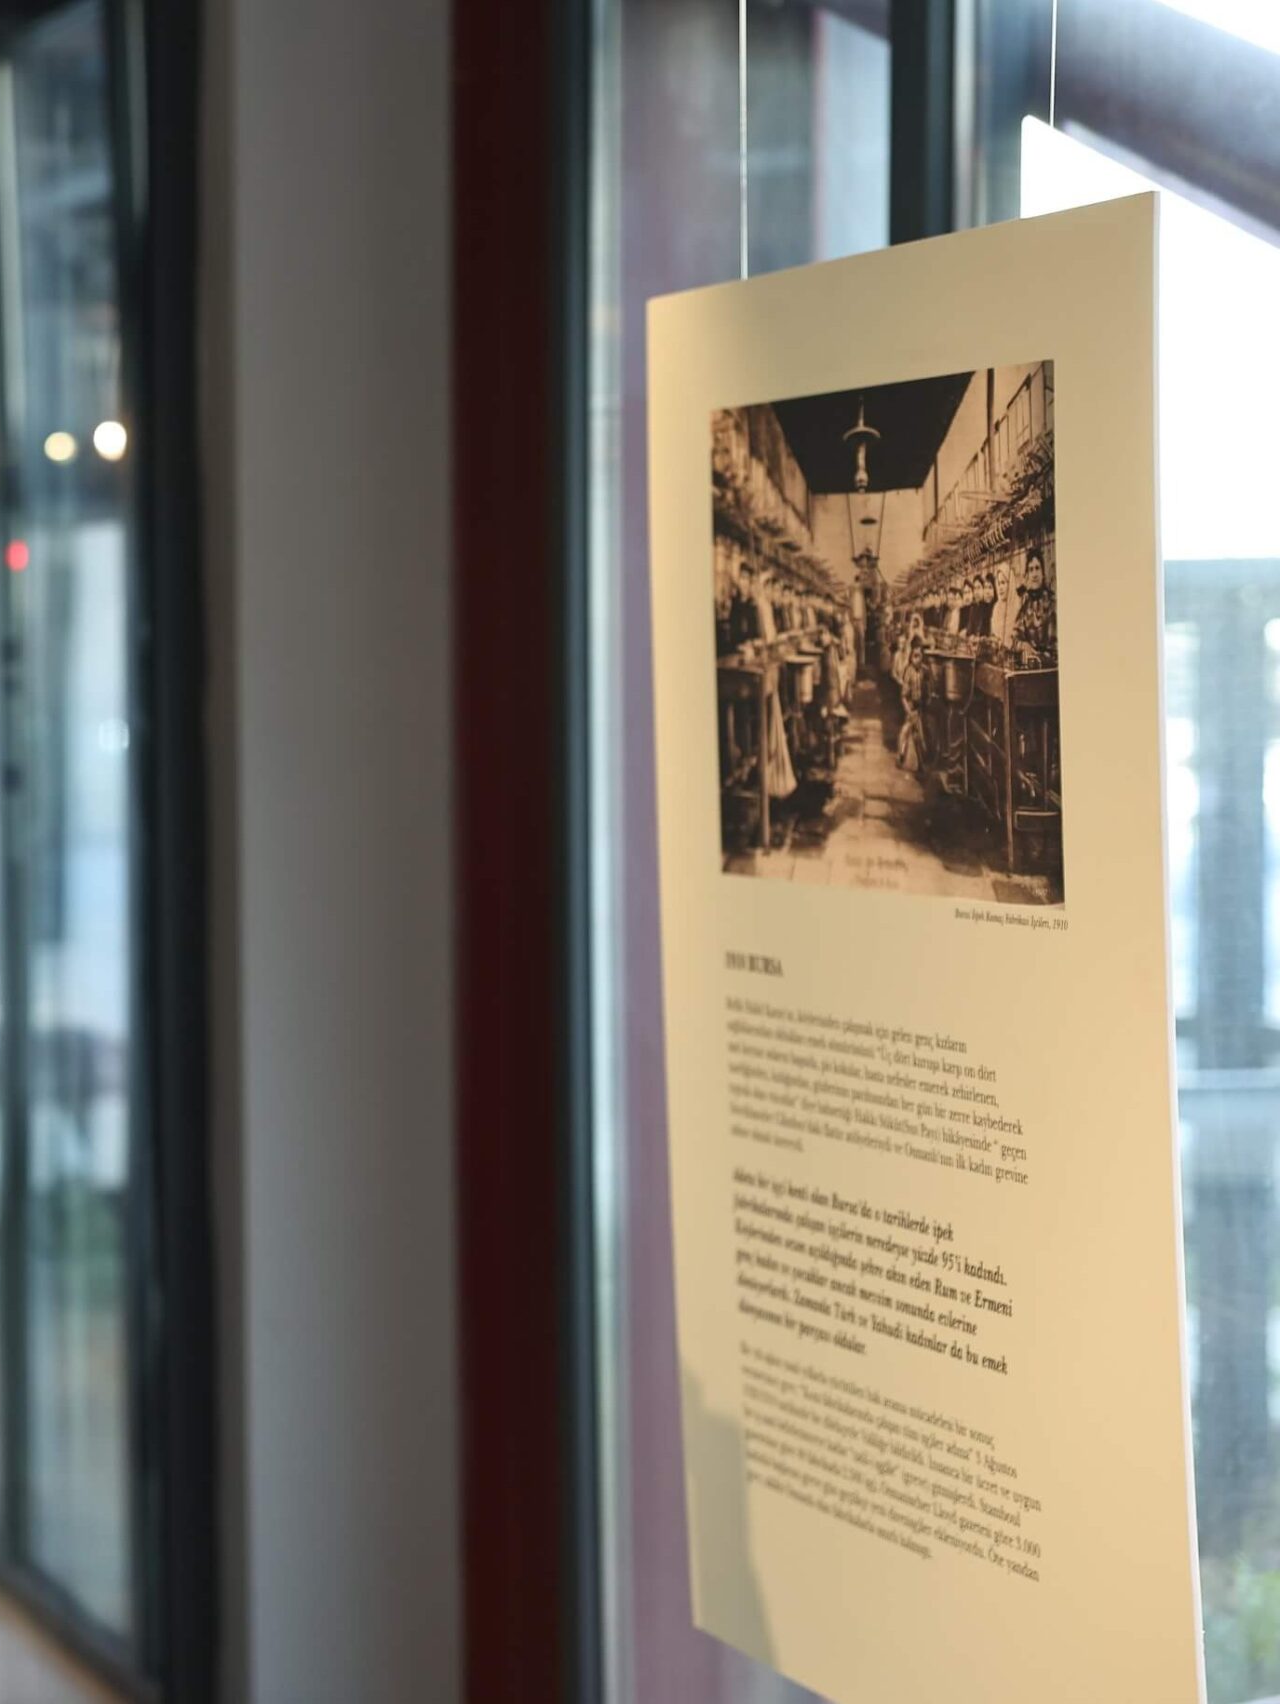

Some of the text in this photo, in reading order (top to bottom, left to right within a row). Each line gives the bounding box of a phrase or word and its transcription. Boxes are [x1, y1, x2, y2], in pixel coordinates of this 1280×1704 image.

[978, 1063, 997, 1083] dört
[951, 1085, 1000, 1109] zehirlenen,
[973, 1109, 1024, 1136] kaybederek
[1001, 1143, 1027, 1163] geçen
[968, 1154, 993, 1177] kadın
[995, 1165, 1029, 1186] grevine
[883, 1207, 930, 1236] tarihlerde
[932, 1219, 954, 1246] ipek
[964, 1257, 1008, 1287] kadındı.
[934, 1277, 958, 1301] Rum
[974, 1289, 1013, 1318] Ermeni
[965, 1343, 979, 1366] bu
[981, 1353, 1008, 1376] emek
